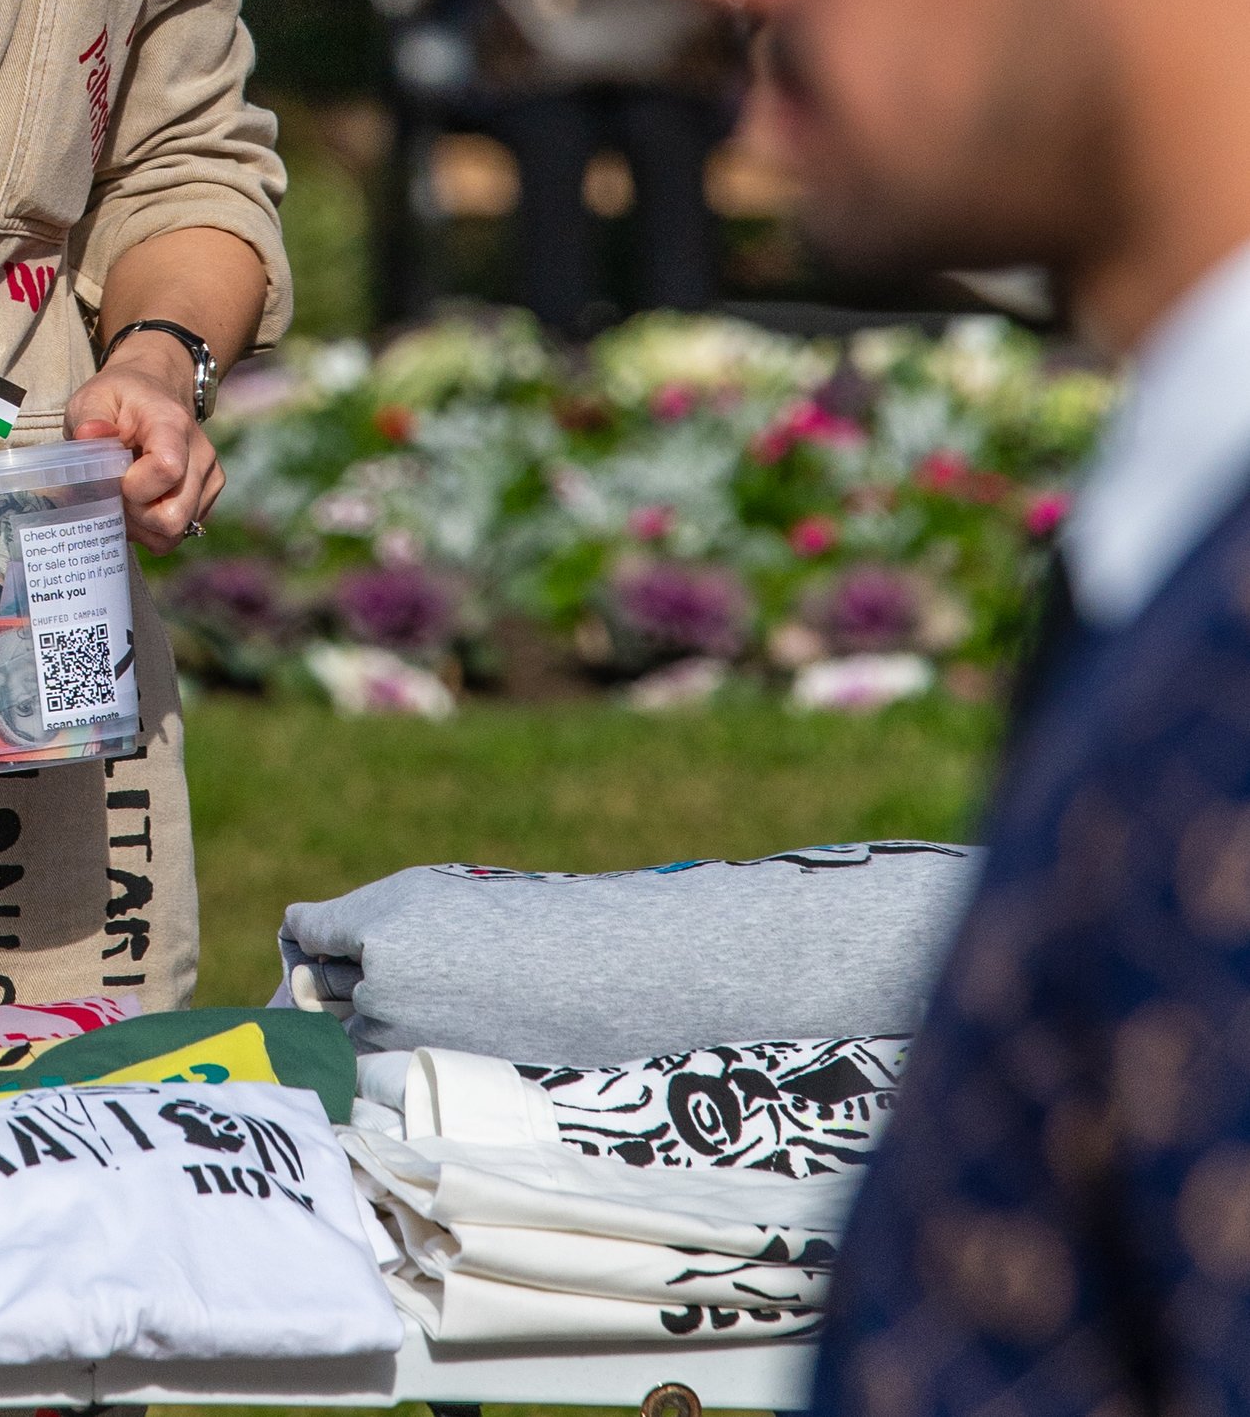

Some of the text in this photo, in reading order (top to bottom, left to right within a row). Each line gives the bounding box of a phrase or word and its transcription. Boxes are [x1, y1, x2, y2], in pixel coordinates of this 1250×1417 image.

[24, 528, 57, 542] check
[59, 528, 76, 538] out
[78, 523, 92, 533] the
[26, 544, 65, 557] one-off
[68, 538, 98, 553] protest
[28, 562, 43, 573] for
[45, 559, 66, 570] sale
[68, 557, 79, 567] to
[80, 553, 100, 564] raise
[29, 579, 41, 588] or
[43, 574, 62, 588] just
[64, 571, 86, 583] chip
[88, 568, 96, 579] in
[97, 567, 102, 578] if
[103, 566, 116, 578] you
[31, 587, 87, 603] thank you
[32, 607, 108, 626] CHUFFED CAMPAIGN
[47, 711, 120, 731] scan to donate
[102, 746, 154, 987] LITARI
